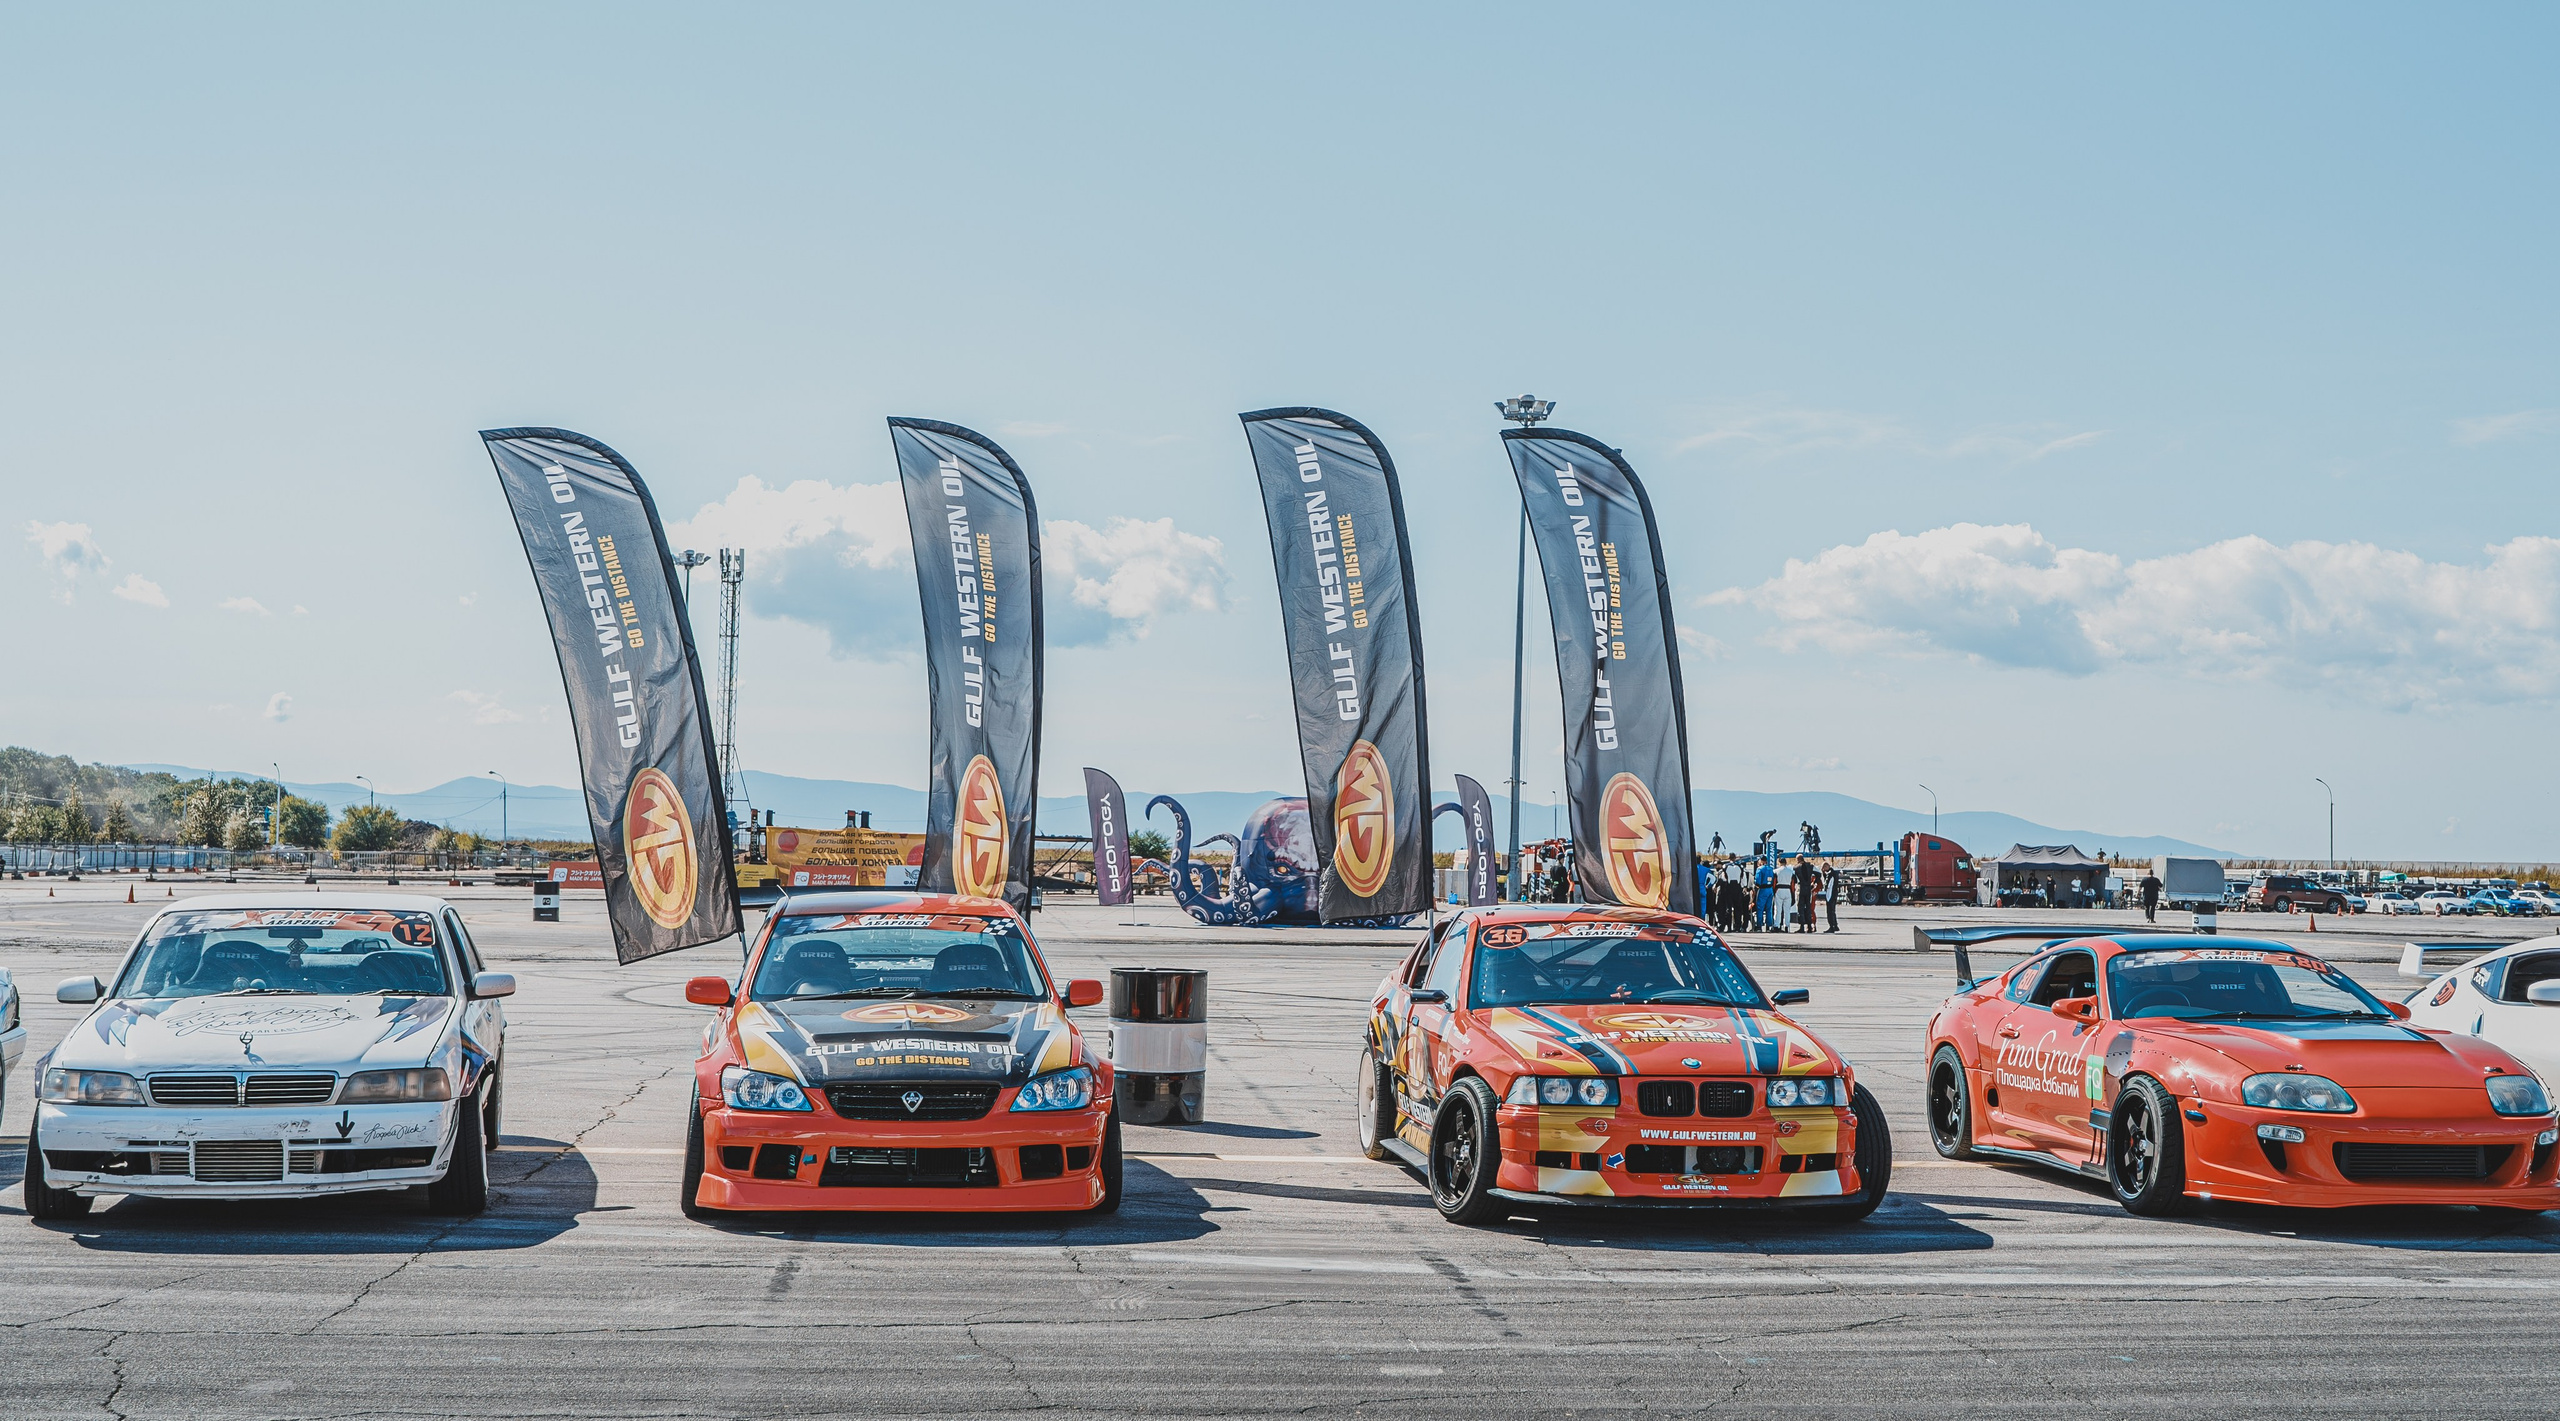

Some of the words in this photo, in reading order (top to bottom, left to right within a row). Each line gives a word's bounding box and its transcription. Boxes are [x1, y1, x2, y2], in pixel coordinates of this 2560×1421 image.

[1296, 438, 1322, 481] OIL
[542, 460, 575, 503] OIL
[938, 454, 966, 497] OIL
[1554, 462, 1585, 507] OIL
[1338, 513, 1362, 578] DISTANCE
[597, 535, 630, 598] DISTANCE
[945, 505, 979, 638] WESTERN
[976, 532, 995, 592] DISTANCE
[1303, 489, 1344, 633] WESTERN
[1600, 542, 1622, 607] DISTANCE
[560, 512, 623, 657] WESTERN
[1349, 580, 1366, 607] THE
[1569, 514, 1608, 660] WESTERN
[619, 600, 638, 626] THE
[981, 595, 996, 621] THE
[1353, 608, 1368, 629] GO
[1610, 609, 1624, 637] THE
[627, 628, 645, 648] GO
[984, 623, 996, 643] GO
[1613, 639, 1626, 660] GO
[964, 646, 984, 728] GULF
[1328, 642, 1361, 721] GULF
[606, 664, 641, 748] GULF
[1594, 669, 1618, 751] GULF
[1341, 756, 1385, 865] GW
[632, 784, 686, 917] GW
[805, 858, 857, 866] БОЛЬШОЙ
[861, 858, 903, 867] ХОККЕЙ
[858, 847, 899, 855] ПОБЕДЫ
[399, 923, 433, 941] 12
[1488, 928, 1523, 944] 36
[215, 952, 260, 960] BRIDE
[805, 1043, 864, 1056] GULF
[870, 1038, 979, 1052] WESTERN
[986, 1044, 1023, 1056] OIL
[1566, 1031, 1622, 1044] GULF
[1625, 1030, 1731, 1040] WESTERN
[1735, 1033, 1774, 1045] OIL
[855, 1056, 874, 1066] GO
[876, 1055, 904, 1065] THE
[905, 1055, 971, 1066] DISTANCE
[1997, 1068, 2040, 1092] Площадка
[2042, 1077, 2080, 1098] событий
[2086, 1066, 2101, 1089] FQ
[1640, 1129, 1756, 1140] WWW.GULFWESTERN.RU
